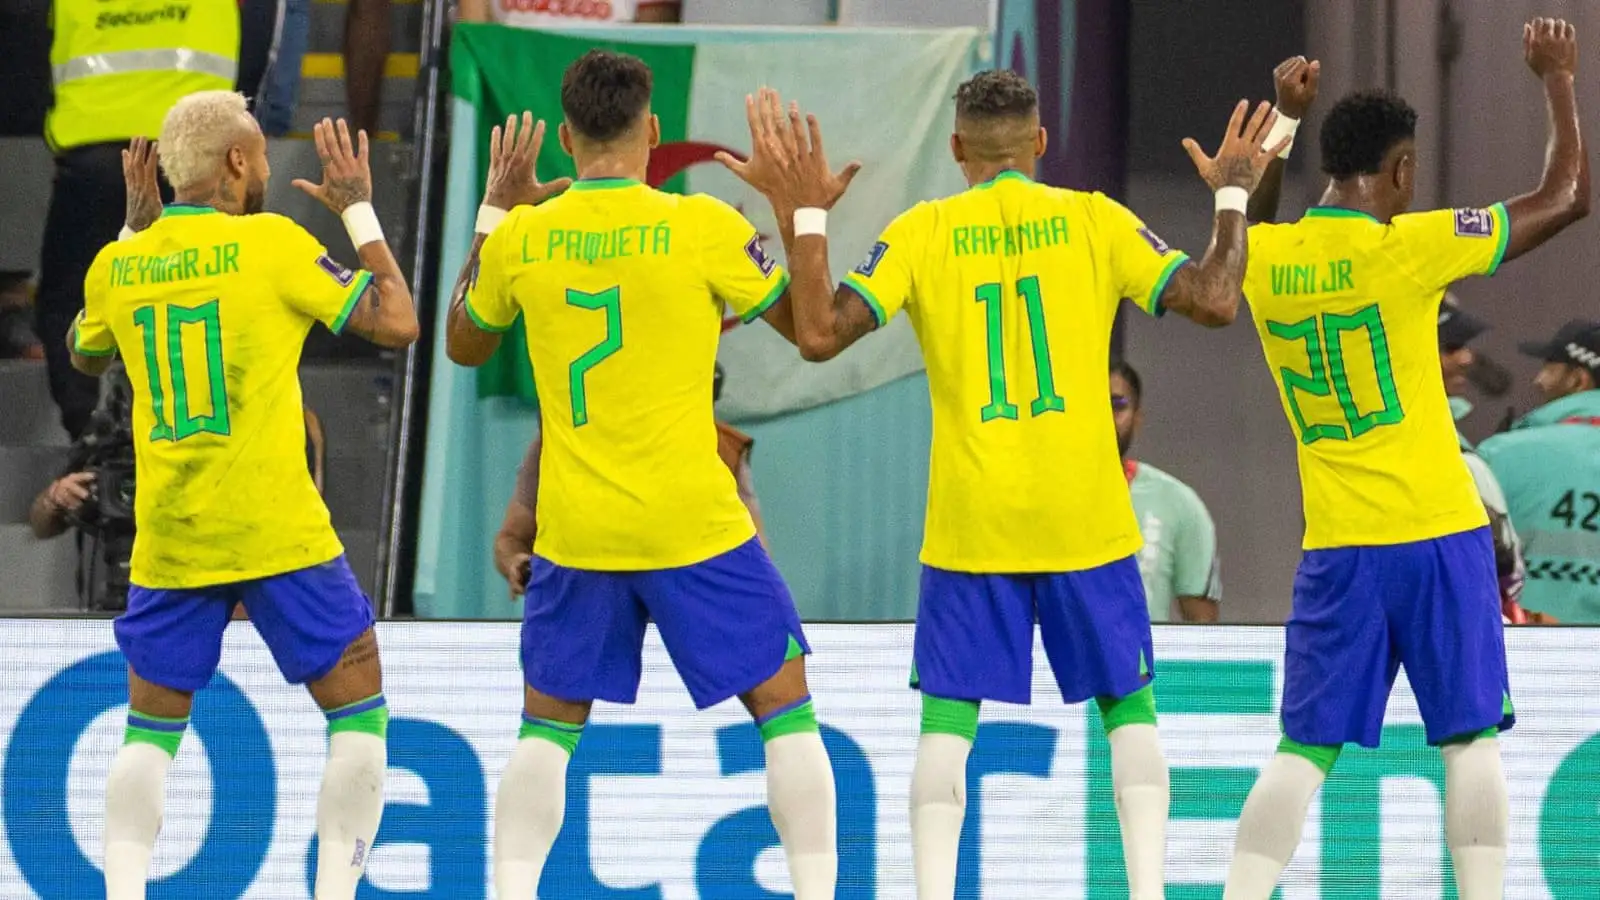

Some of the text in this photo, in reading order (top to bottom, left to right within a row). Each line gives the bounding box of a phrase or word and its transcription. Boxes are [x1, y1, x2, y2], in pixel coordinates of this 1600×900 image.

[96, 5, 191, 29] Security
[546, 219, 671, 264] PAQUETÁ
[109, 242, 240, 288] NEYMAR JR
[1270, 258, 1354, 296] VINI JR
[133, 298, 231, 442] 10
[565, 285, 623, 428] 7
[975, 275, 1065, 423] 11
[1266, 302, 1405, 445] 20
[1550, 488, 1600, 533] 42
